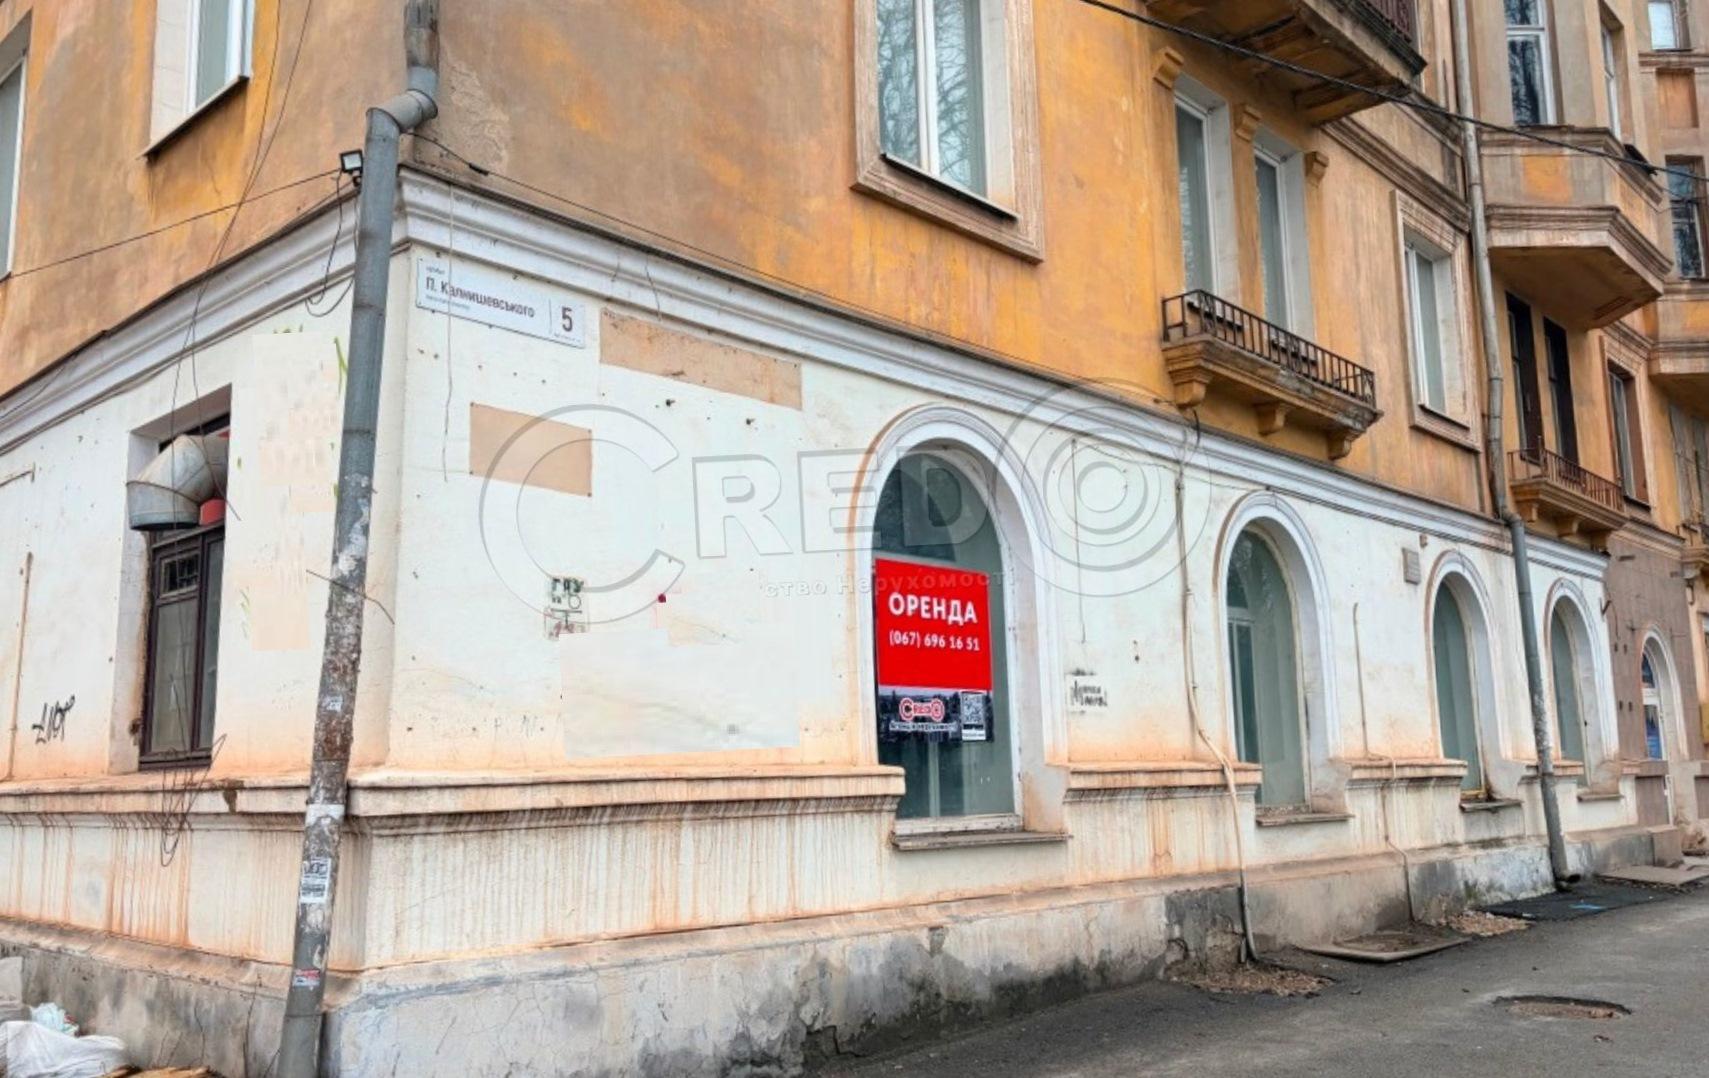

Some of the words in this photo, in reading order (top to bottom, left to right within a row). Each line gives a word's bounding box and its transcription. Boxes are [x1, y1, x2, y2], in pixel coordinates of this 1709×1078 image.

[426, 276, 437, 291] П.
[441, 281, 535, 318] Калнишевського
[561, 306, 573, 332] 5
[889, 592, 978, 626] ОРЕНДА
[889, 629, 920, 648] (067)
[924, 633, 946, 648] 696
[949, 636, 964, 649] 16
[966, 637, 980, 651] 51
